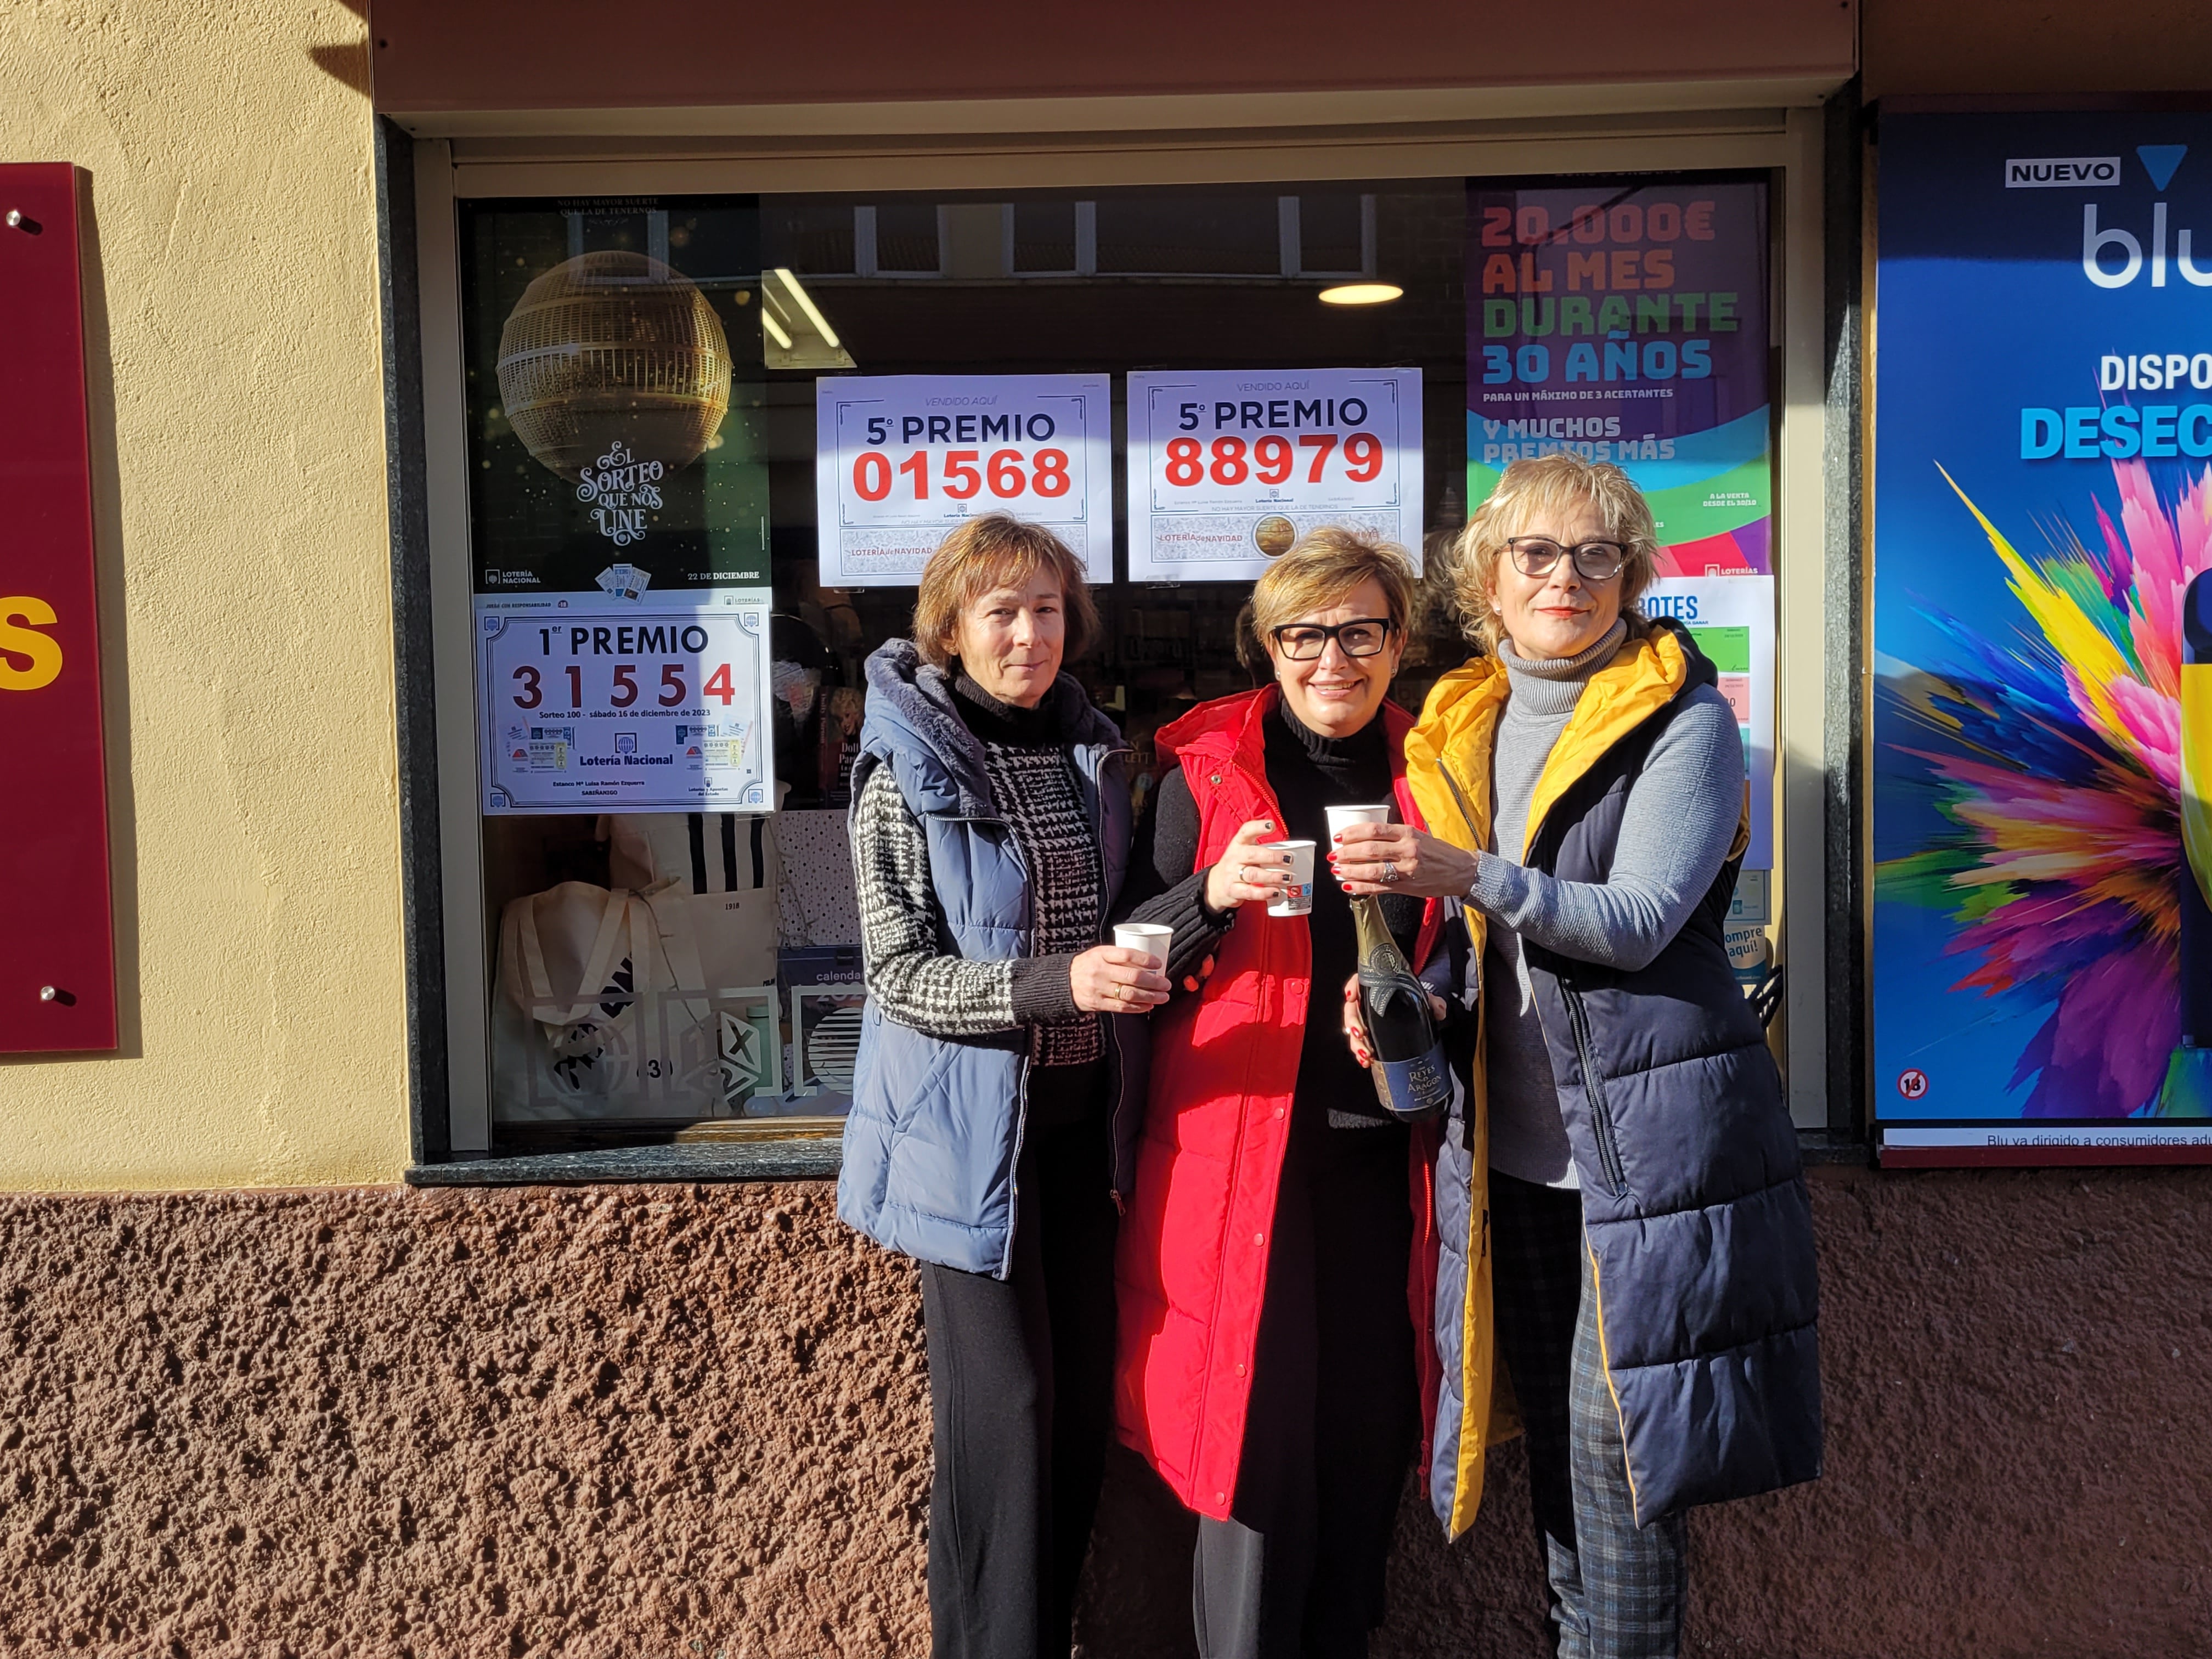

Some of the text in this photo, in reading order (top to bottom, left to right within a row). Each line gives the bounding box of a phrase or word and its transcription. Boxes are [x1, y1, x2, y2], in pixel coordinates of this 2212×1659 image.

[2011, 163, 2115, 182] NUEVO
[560, 208, 580, 218] QUE
[610, 206, 657, 215] TENERNOS
[1481, 201, 1715, 246] 20.000€
[1482, 249, 1674, 293] AL MES
[1483, 292, 1738, 337] DURANTE
[1482, 330, 1712, 383] 30 AÑOS
[2101, 353, 2212, 390] DISPO
[1238, 380, 1310, 392] VENDIDO AQUÍ
[1483, 388, 1673, 402] PARA UN MÁXIMO DE 3 ACERTANTES
[926, 394, 998, 406] VENDIDO AQUÍ
[1179, 398, 1368, 431] 5º PREMIO
[1483, 416, 1621, 439] Y MUCHOS
[866, 414, 1055, 445] 5º PREMIO
[2021, 404, 2212, 459] DESEC
[596, 441, 635, 469] EL
[1165, 433, 1383, 486] 88979
[1484, 433, 1675, 463] PREMIOS MÁS
[577, 461, 663, 502] SORTEO
[853, 448, 1070, 501] 01568
[598, 484, 663, 510] QUE NOS
[590, 509, 647, 546] UNE
[894, 547, 933, 555] NAVIDAD
[713, 571, 760, 579] DICIEMBRE
[0, 596, 63, 690] S
[571, 625, 708, 655] PREMIO
[641, 709, 679, 717] diciembre
[580, 754, 673, 766] Lotería Nacional
[842, 743, 860, 753] Doll
[1725, 928, 1762, 943] ompre
[1729, 940, 1758, 958] aquí!
[1408, 1064, 1435, 1082] REYES
[1988, 1135, 2007, 1146] Blu
[2032, 1135, 2079, 1146] dirigido
[2096, 1134, 2187, 1146] consumidores
